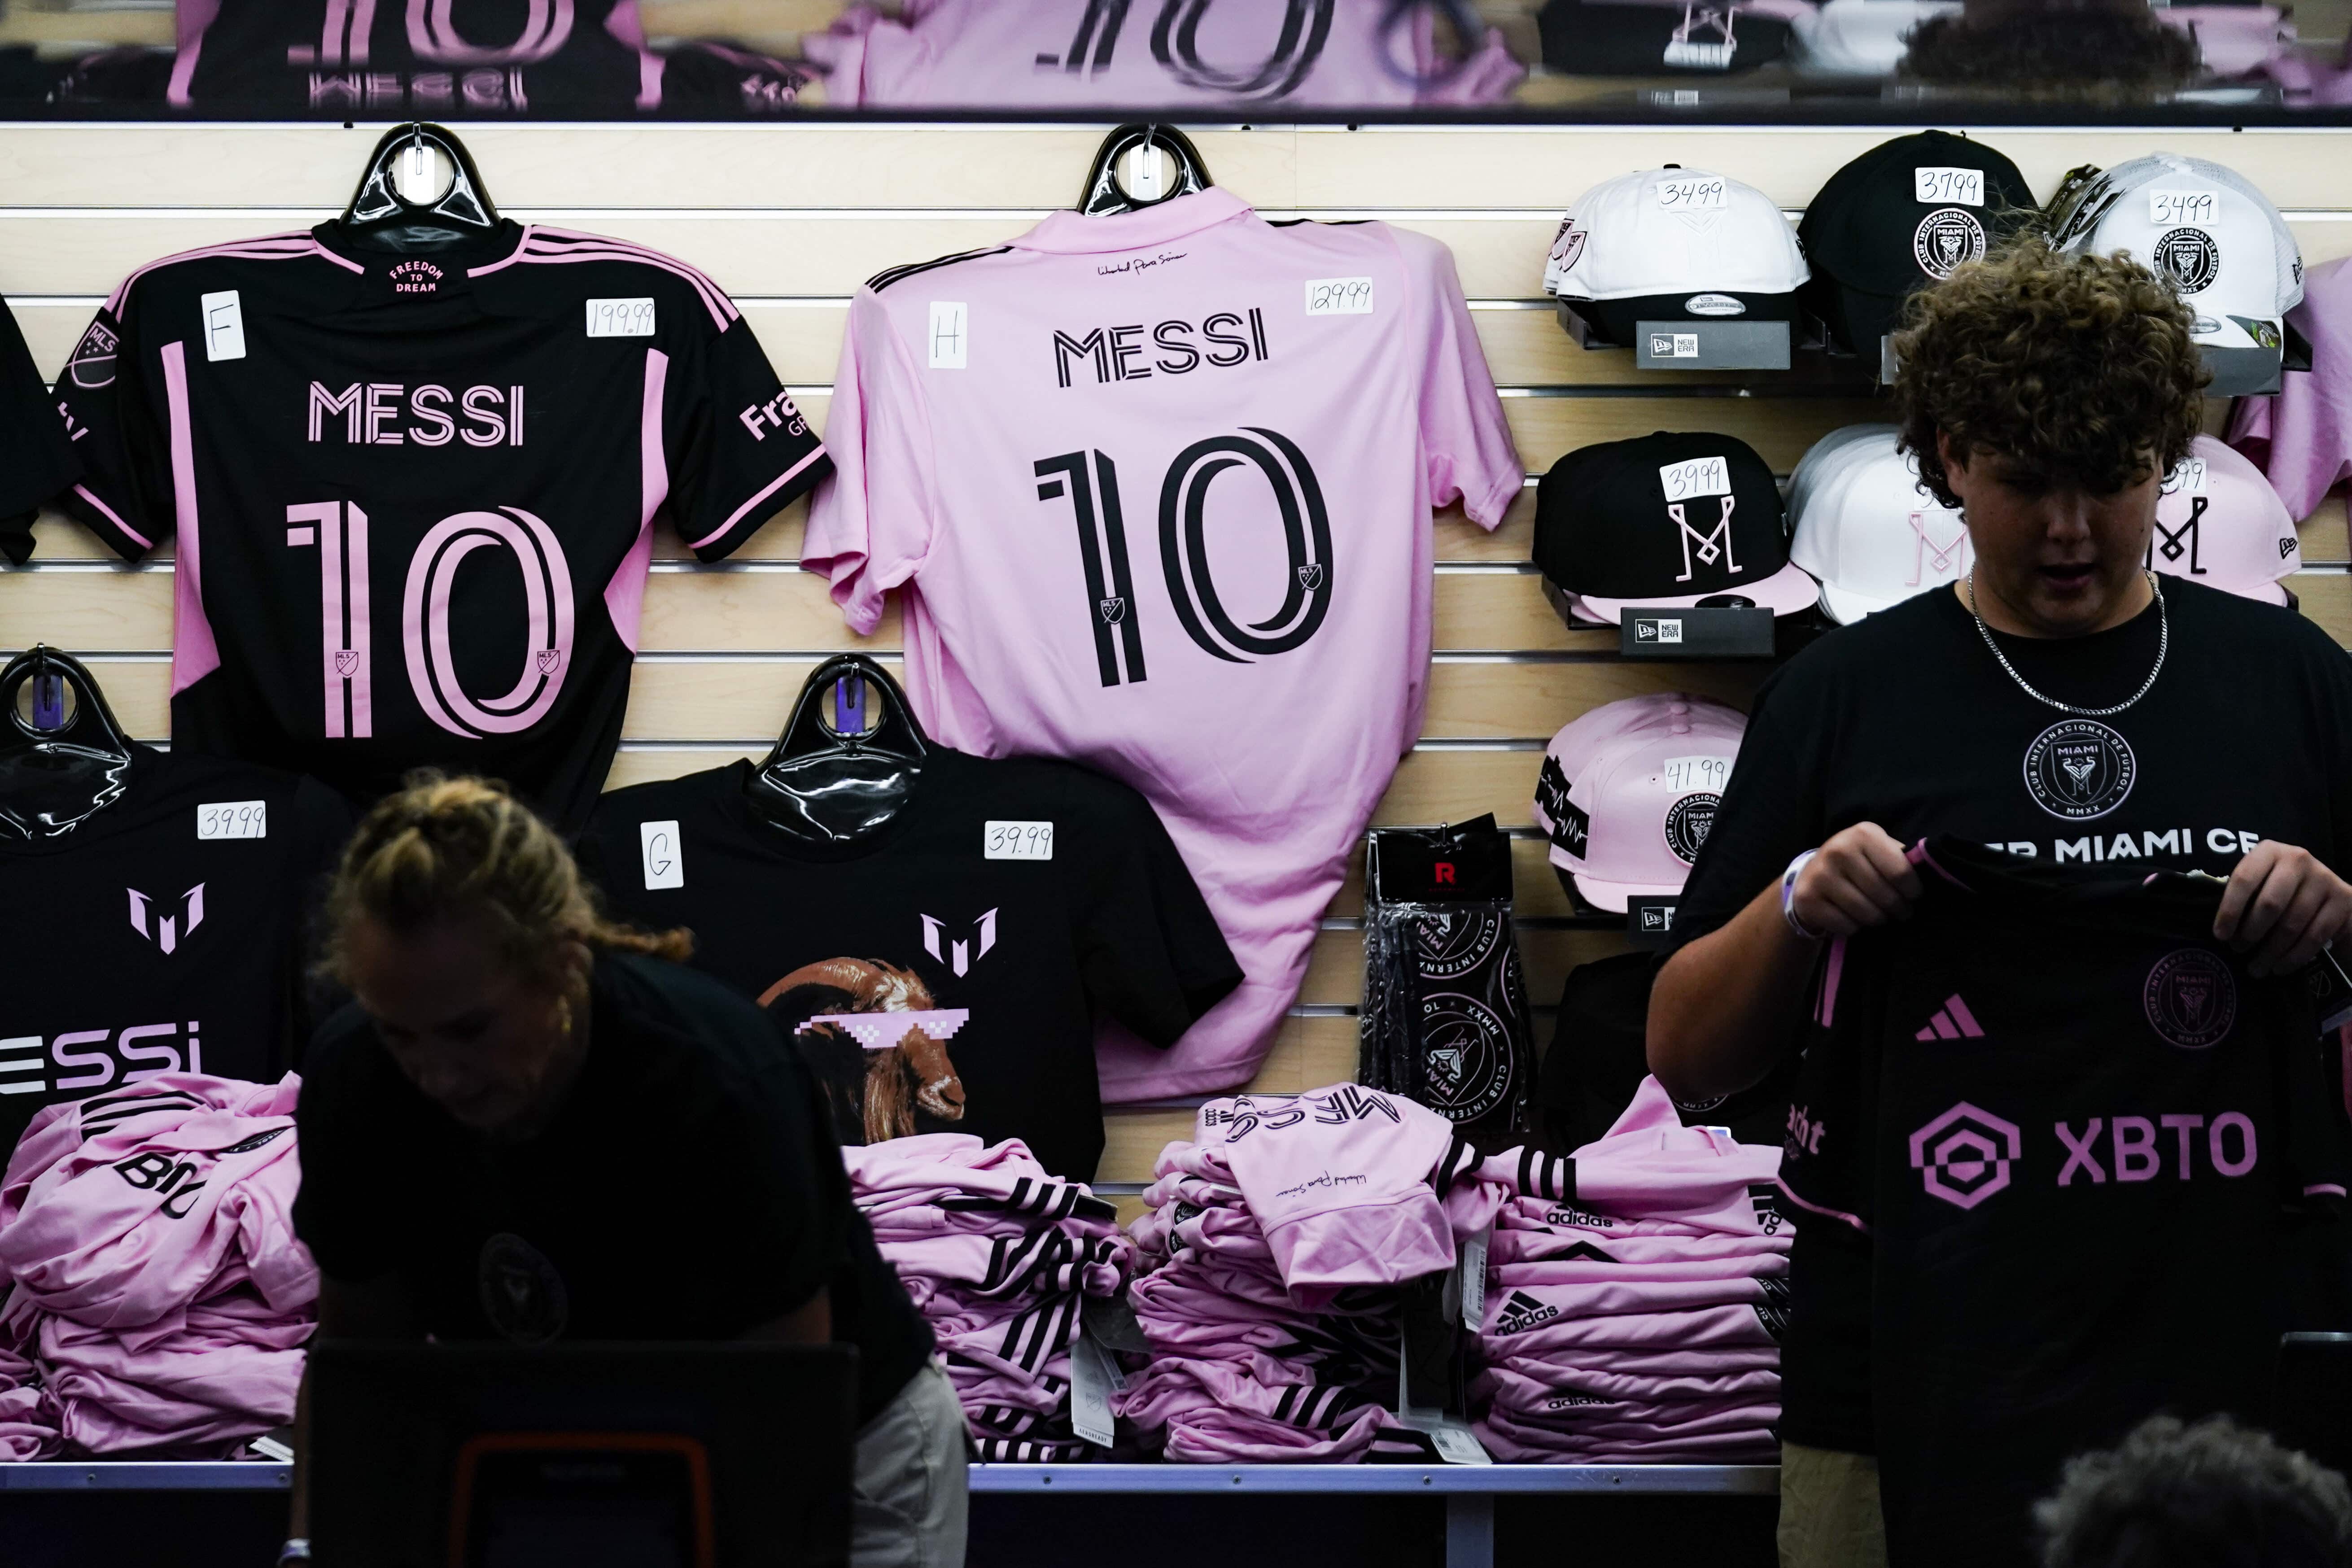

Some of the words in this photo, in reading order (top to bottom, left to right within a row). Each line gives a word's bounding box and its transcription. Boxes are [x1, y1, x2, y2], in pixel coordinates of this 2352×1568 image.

[1919, 212, 1972, 240] INTERNACIONAL
[1971, 225, 1979, 235] DE
[1919, 244, 1928, 263] CLUB
[2155, 229, 2208, 257] INTERNACIONAL
[2208, 242, 2216, 250] DE
[389, 261, 443, 279] FREEDOM
[396, 283, 436, 292] DREAM
[90, 328, 116, 352] MLS
[210, 304, 234, 351] F
[936, 310, 959, 358] H
[1054, 308, 1268, 388] MESSI
[309, 381, 524, 447] MESSI
[1034, 427, 1333, 687] 10
[287, 501, 574, 739] 10
[2030, 724, 2108, 765] INTERNACIONAL
[2058, 745, 2098, 755] MIAMI
[2111, 738, 2124, 751] DE
[2030, 771, 2046, 797] CLUB
[2067, 805, 2100, 815] MMXX
[1667, 828, 1677, 848] CLUB
[2055, 829, 2192, 863] MIAMI
[1435, 862, 1456, 884] R
[1477, 920, 1495, 952] CLUB
[1467, 1005, 1500, 1035] MMXX
[1490, 1065, 1506, 1097] CLUB
[2055, 1111, 2257, 1186] XBTO
[1547, 1210, 1613, 1227] adidas
[1495, 1305, 1559, 1336] adidas
